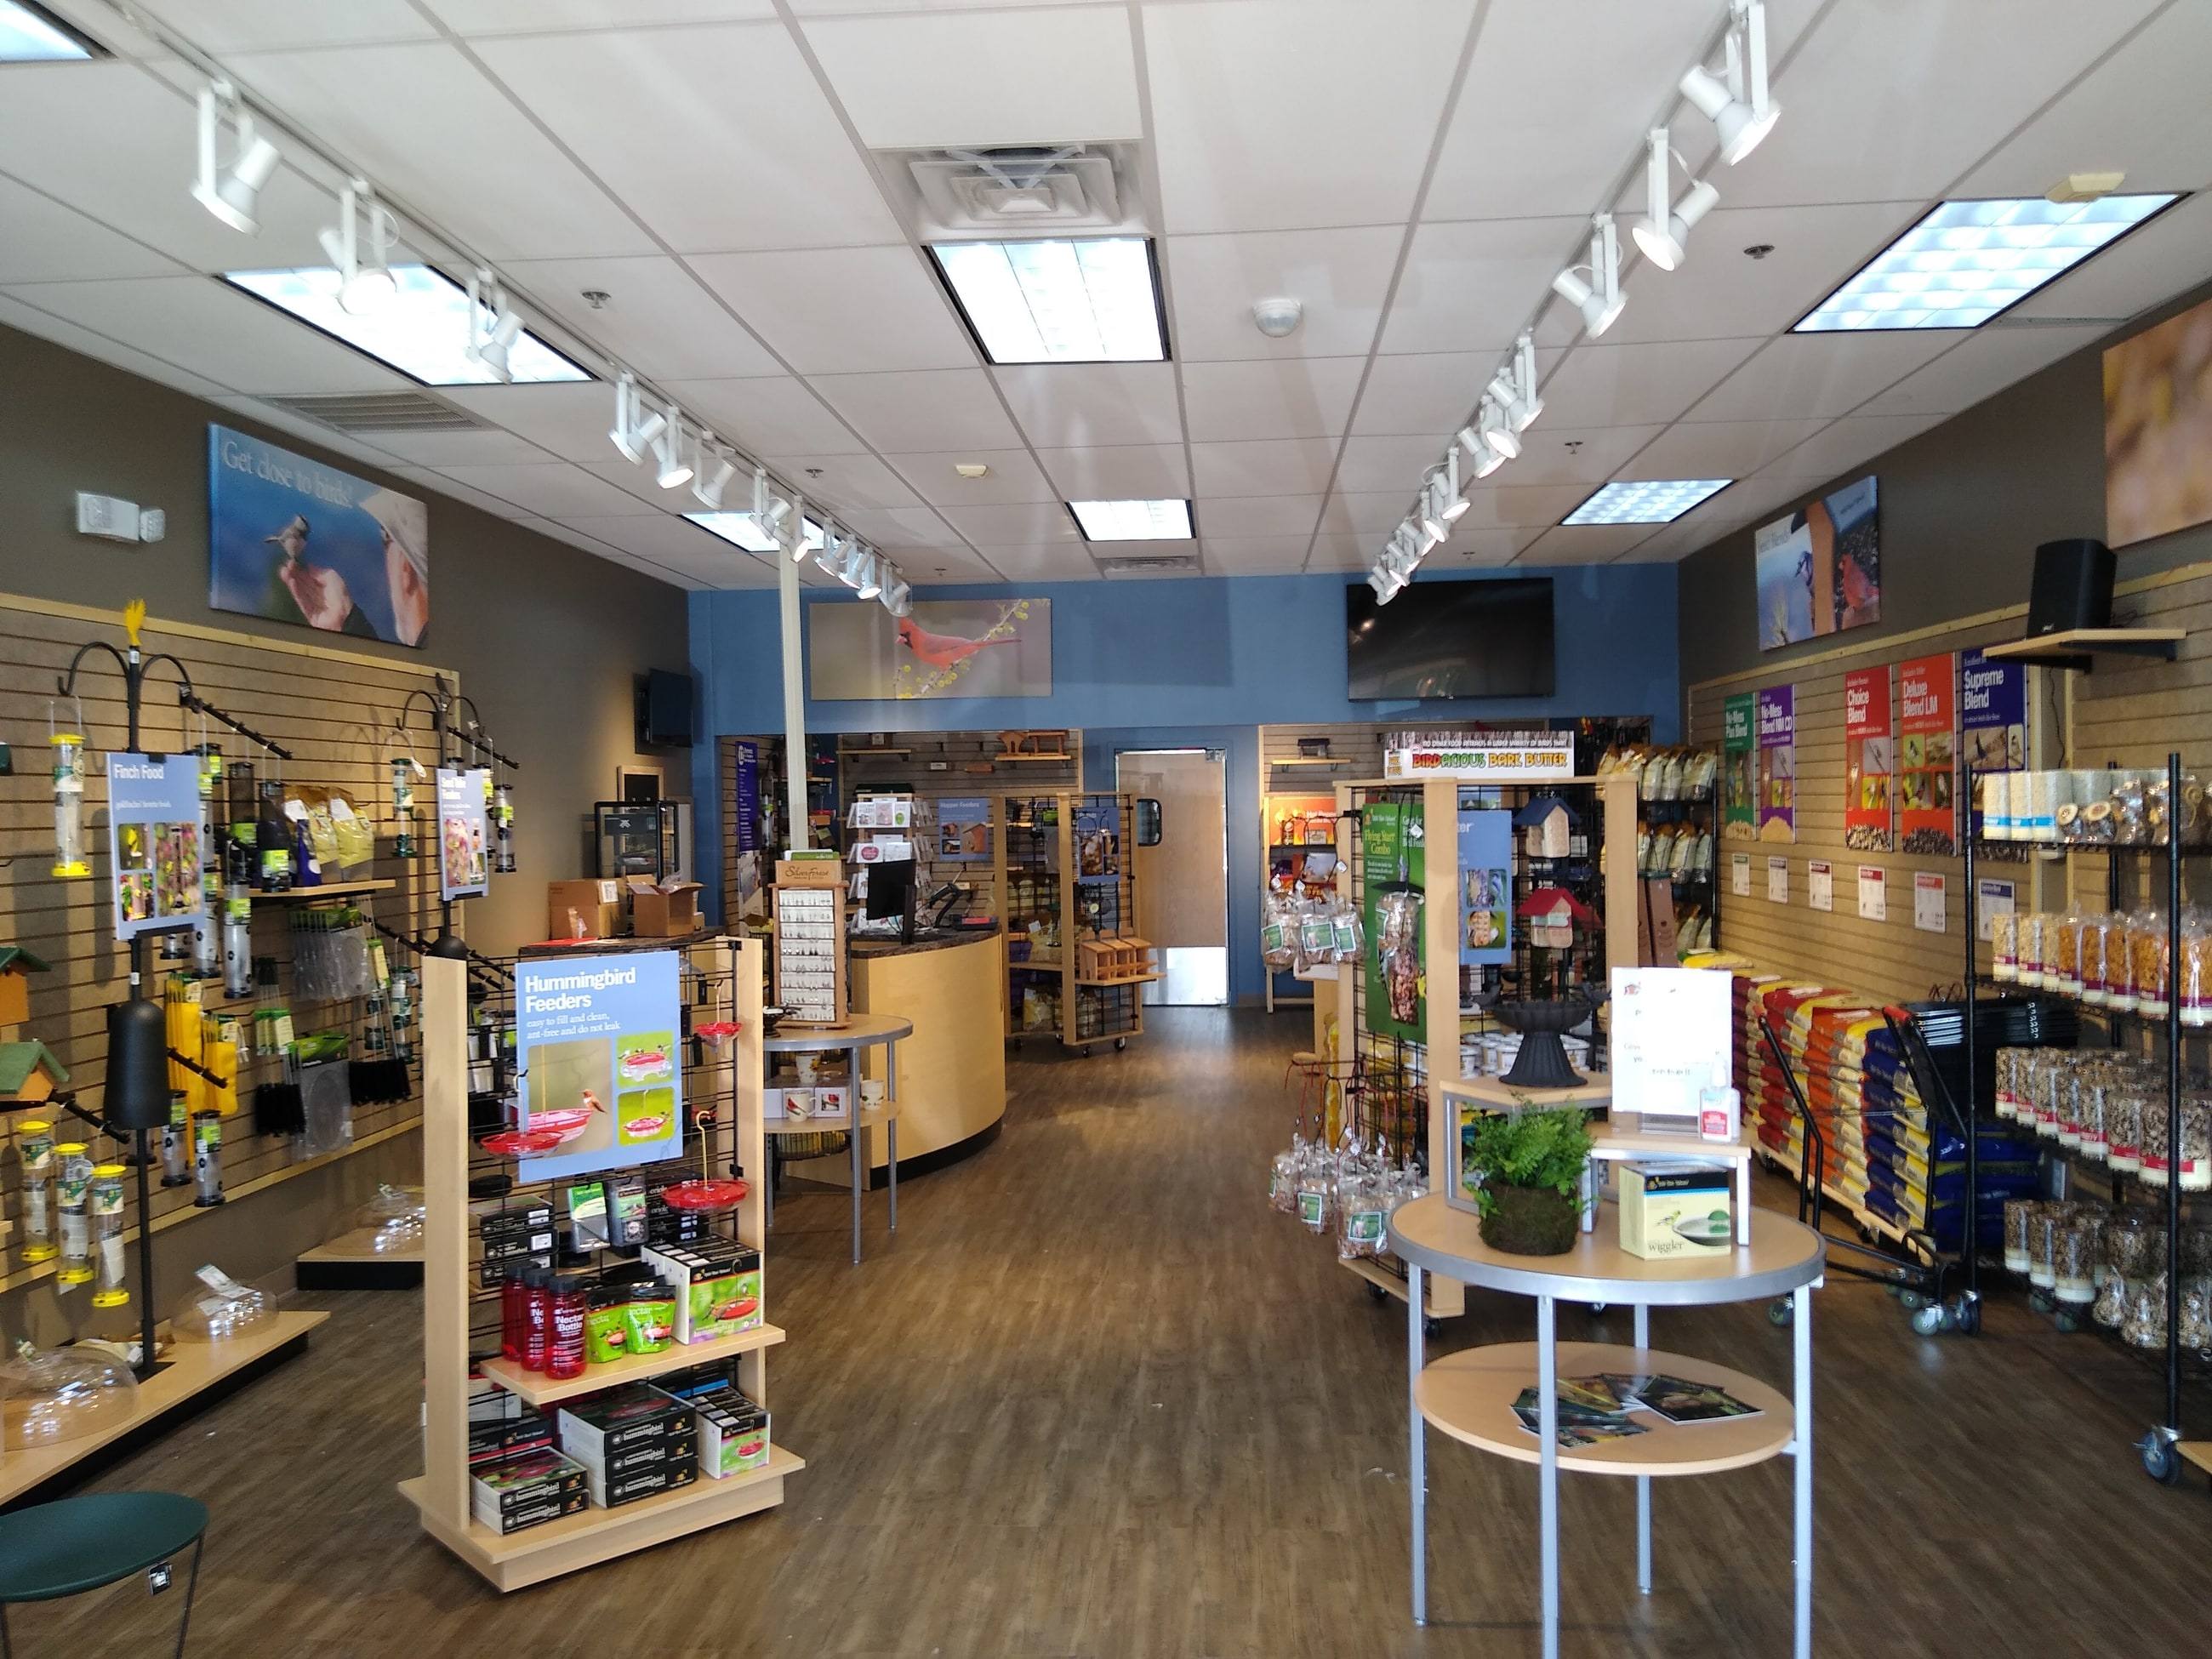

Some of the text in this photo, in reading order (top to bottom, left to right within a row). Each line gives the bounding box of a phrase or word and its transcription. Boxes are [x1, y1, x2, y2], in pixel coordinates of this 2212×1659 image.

[223, 441, 253, 474] Get
[257, 451, 293, 487] close
[297, 472, 312, 494] to
[1903, 679, 1928, 699] Deluxe
[1964, 669, 2004, 693] Supreme
[1847, 687, 1870, 706] Choice
[1964, 687, 1990, 710] Blend
[1847, 704, 1867, 724] Blend
[1902, 698, 1924, 717] Blend
[1412, 752, 1486, 769] BIRDACIOUS
[1489, 752, 1523, 768] BARK
[1525, 752, 1568, 767] BUTTER
[114, 763, 164, 779] Finch Food
[525, 966, 636, 993] Hummingbird
[525, 993, 592, 1013] Feeders
[527, 1012, 610, 1028] easy to fill and clean,
[527, 1021, 622, 1039] ant-free and do not leak
[1649, 1240, 1683, 1253] wiggler
[555, 1314, 584, 1325] Nectar
[556, 1322, 583, 1332] Bottle
[624, 1422, 664, 1440] hummingbird
[624, 1446, 665, 1466] hummingbird
[516, 1481, 560, 1502] hummingbird
[625, 1473, 665, 1492] hummingbird
[516, 1502, 561, 1523] hummingbird
